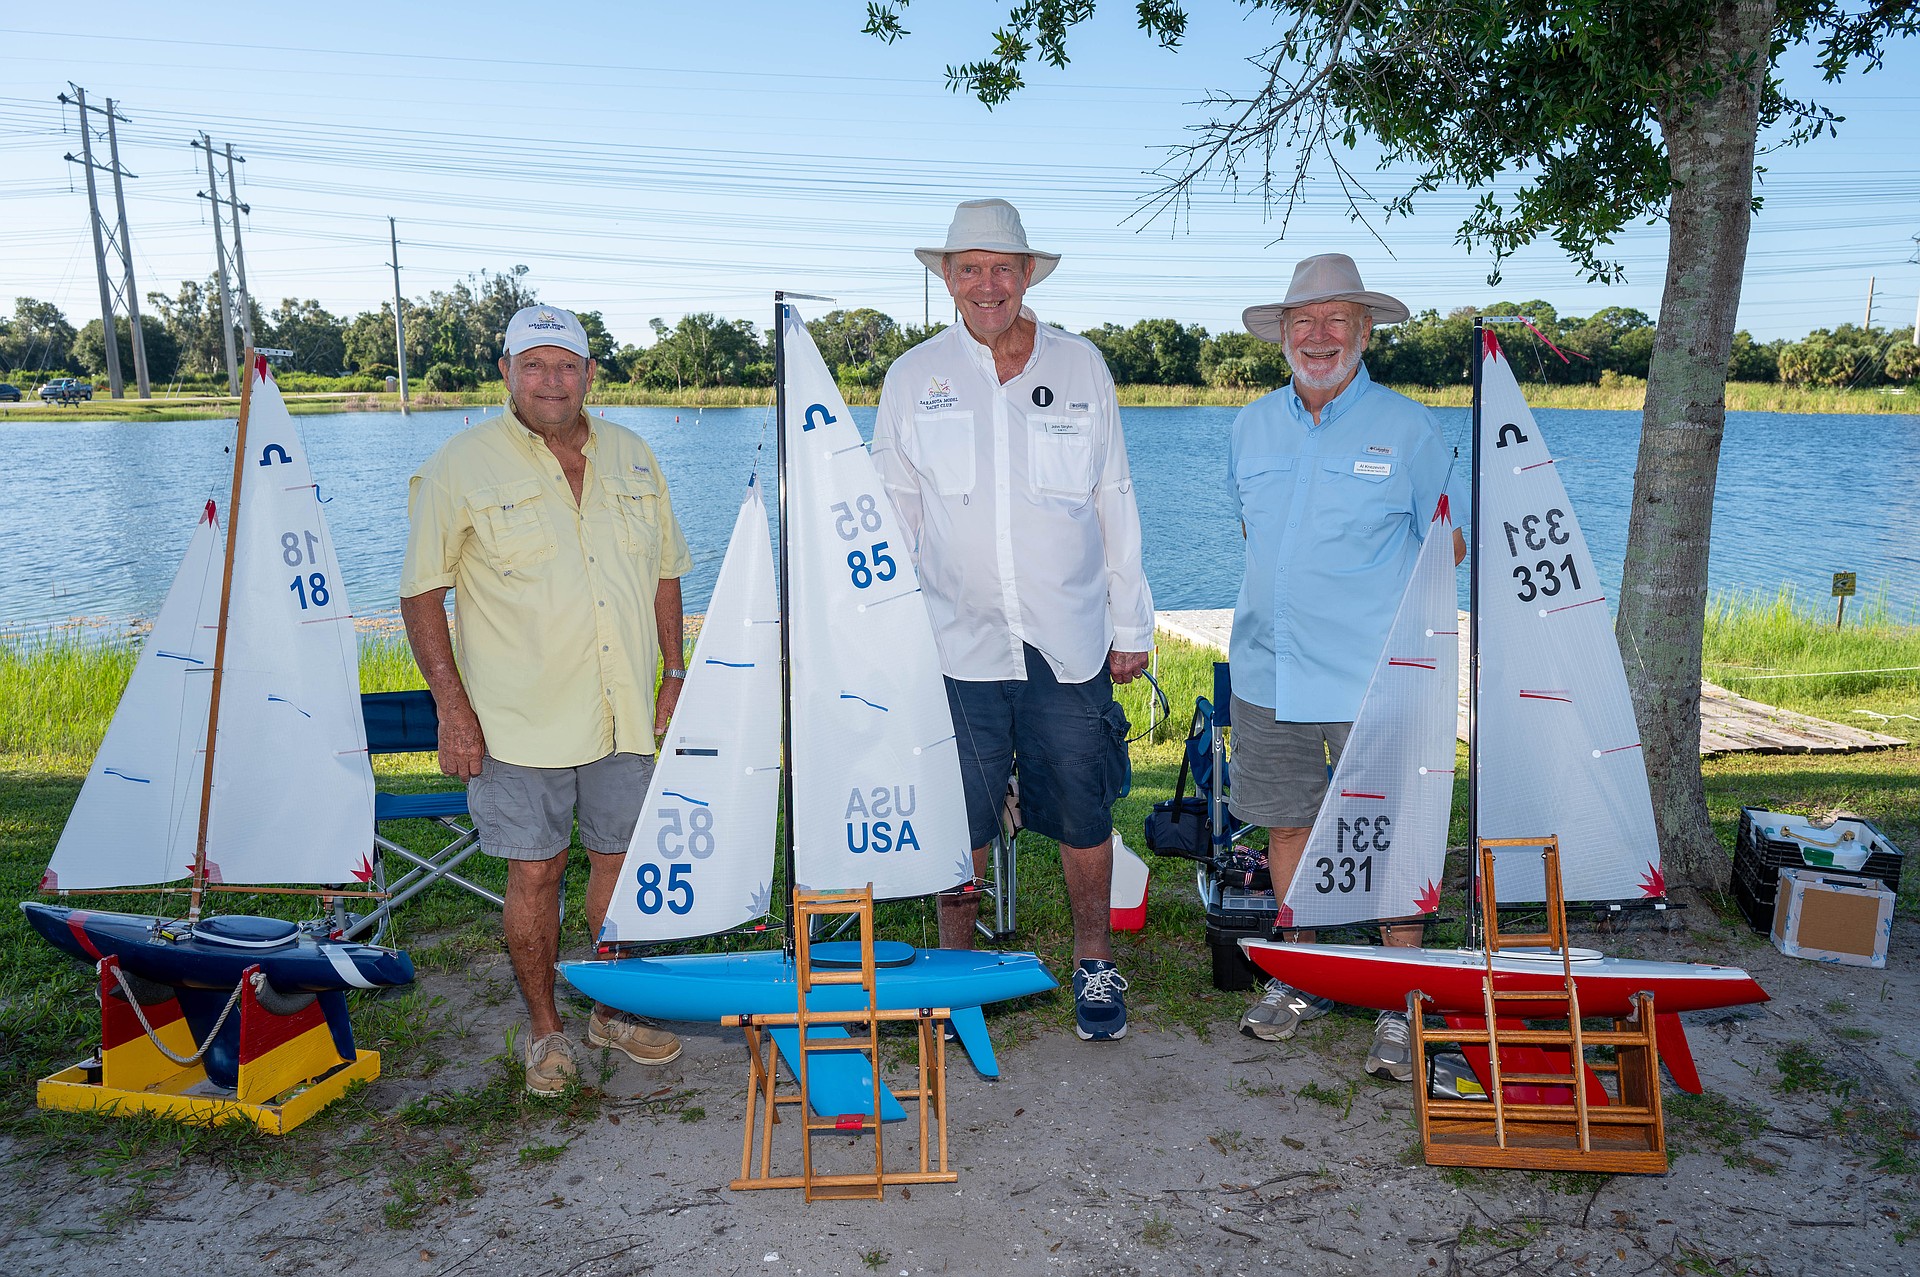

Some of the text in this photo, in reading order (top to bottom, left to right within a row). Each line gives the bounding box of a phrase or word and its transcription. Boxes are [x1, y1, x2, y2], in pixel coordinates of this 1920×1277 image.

[847, 541, 896, 589] 85
[1513, 553, 1582, 602] 331
[290, 572, 329, 609] 18
[847, 820, 921, 854] USA
[636, 862, 694, 915] 85
[1315, 855, 1372, 894] 331
